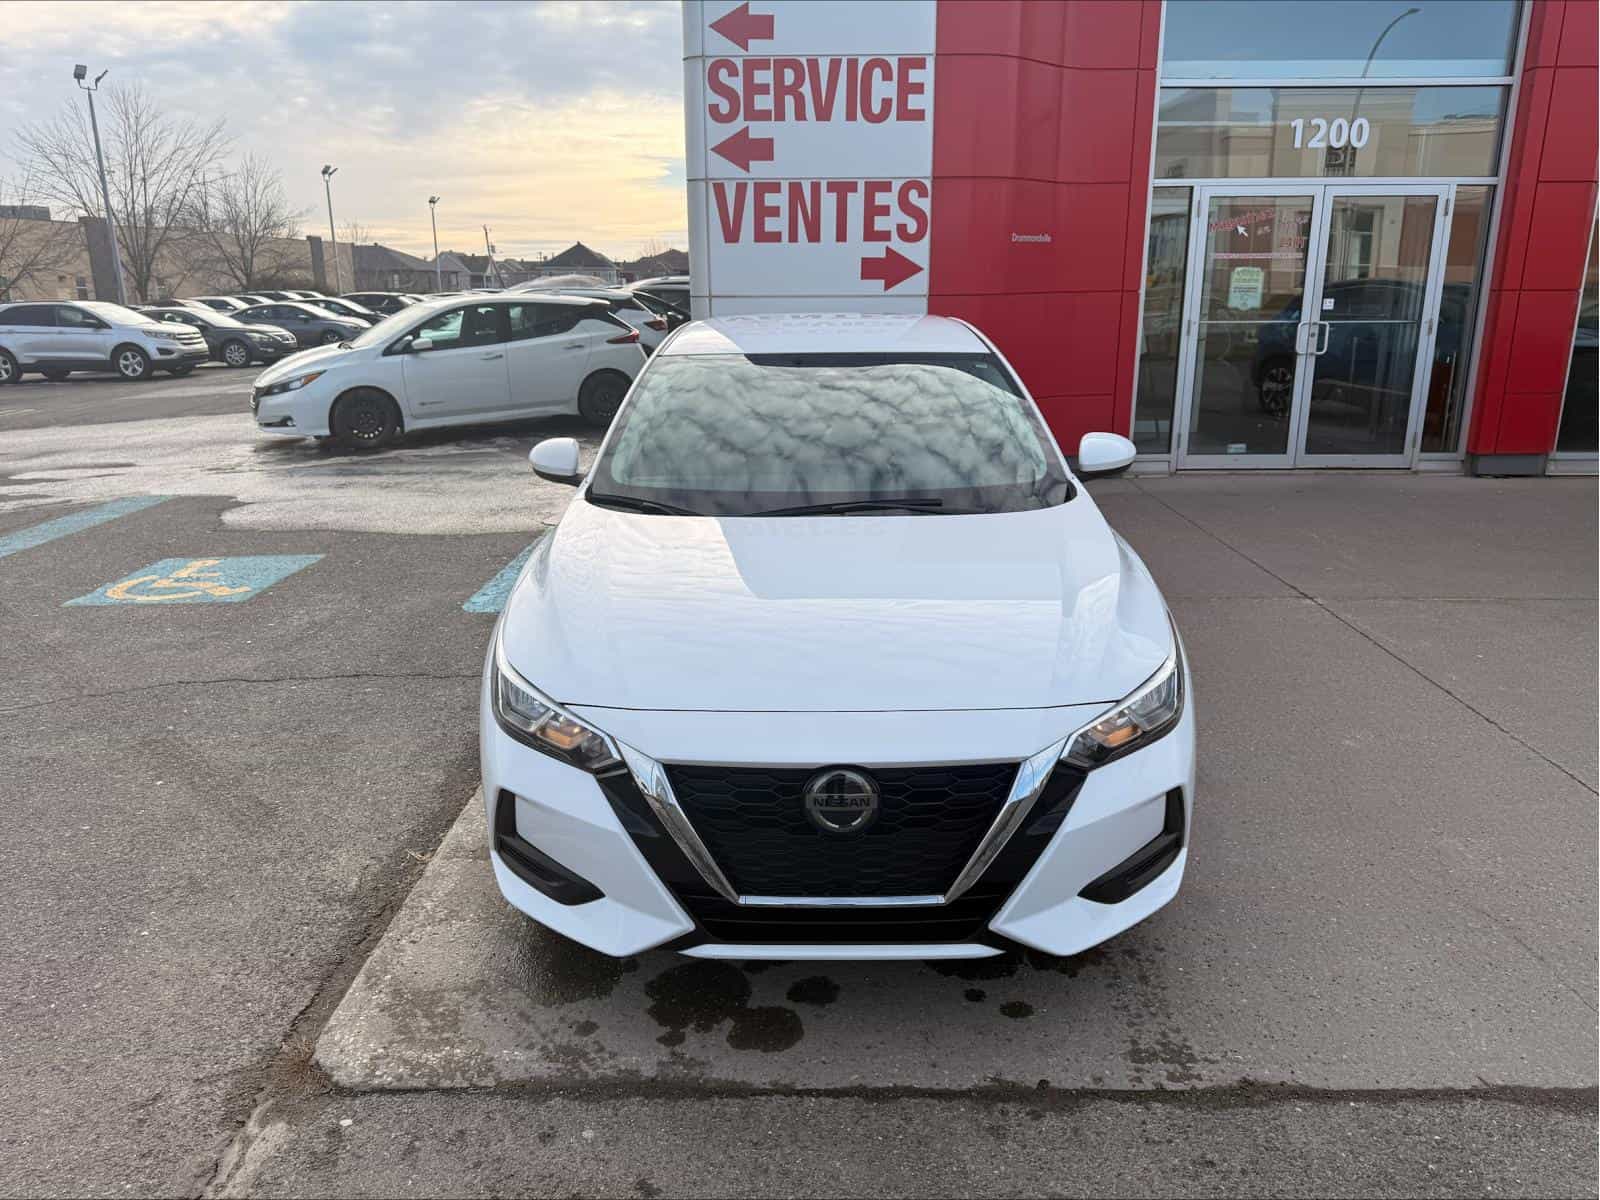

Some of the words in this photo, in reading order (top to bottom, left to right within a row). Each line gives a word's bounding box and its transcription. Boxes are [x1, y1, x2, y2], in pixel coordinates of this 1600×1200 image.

[707, 57, 927, 125] SERVICE
[1291, 117, 1370, 149] 1200
[712, 180, 930, 244] VENTES
[814, 797, 871, 808] NISSAN
